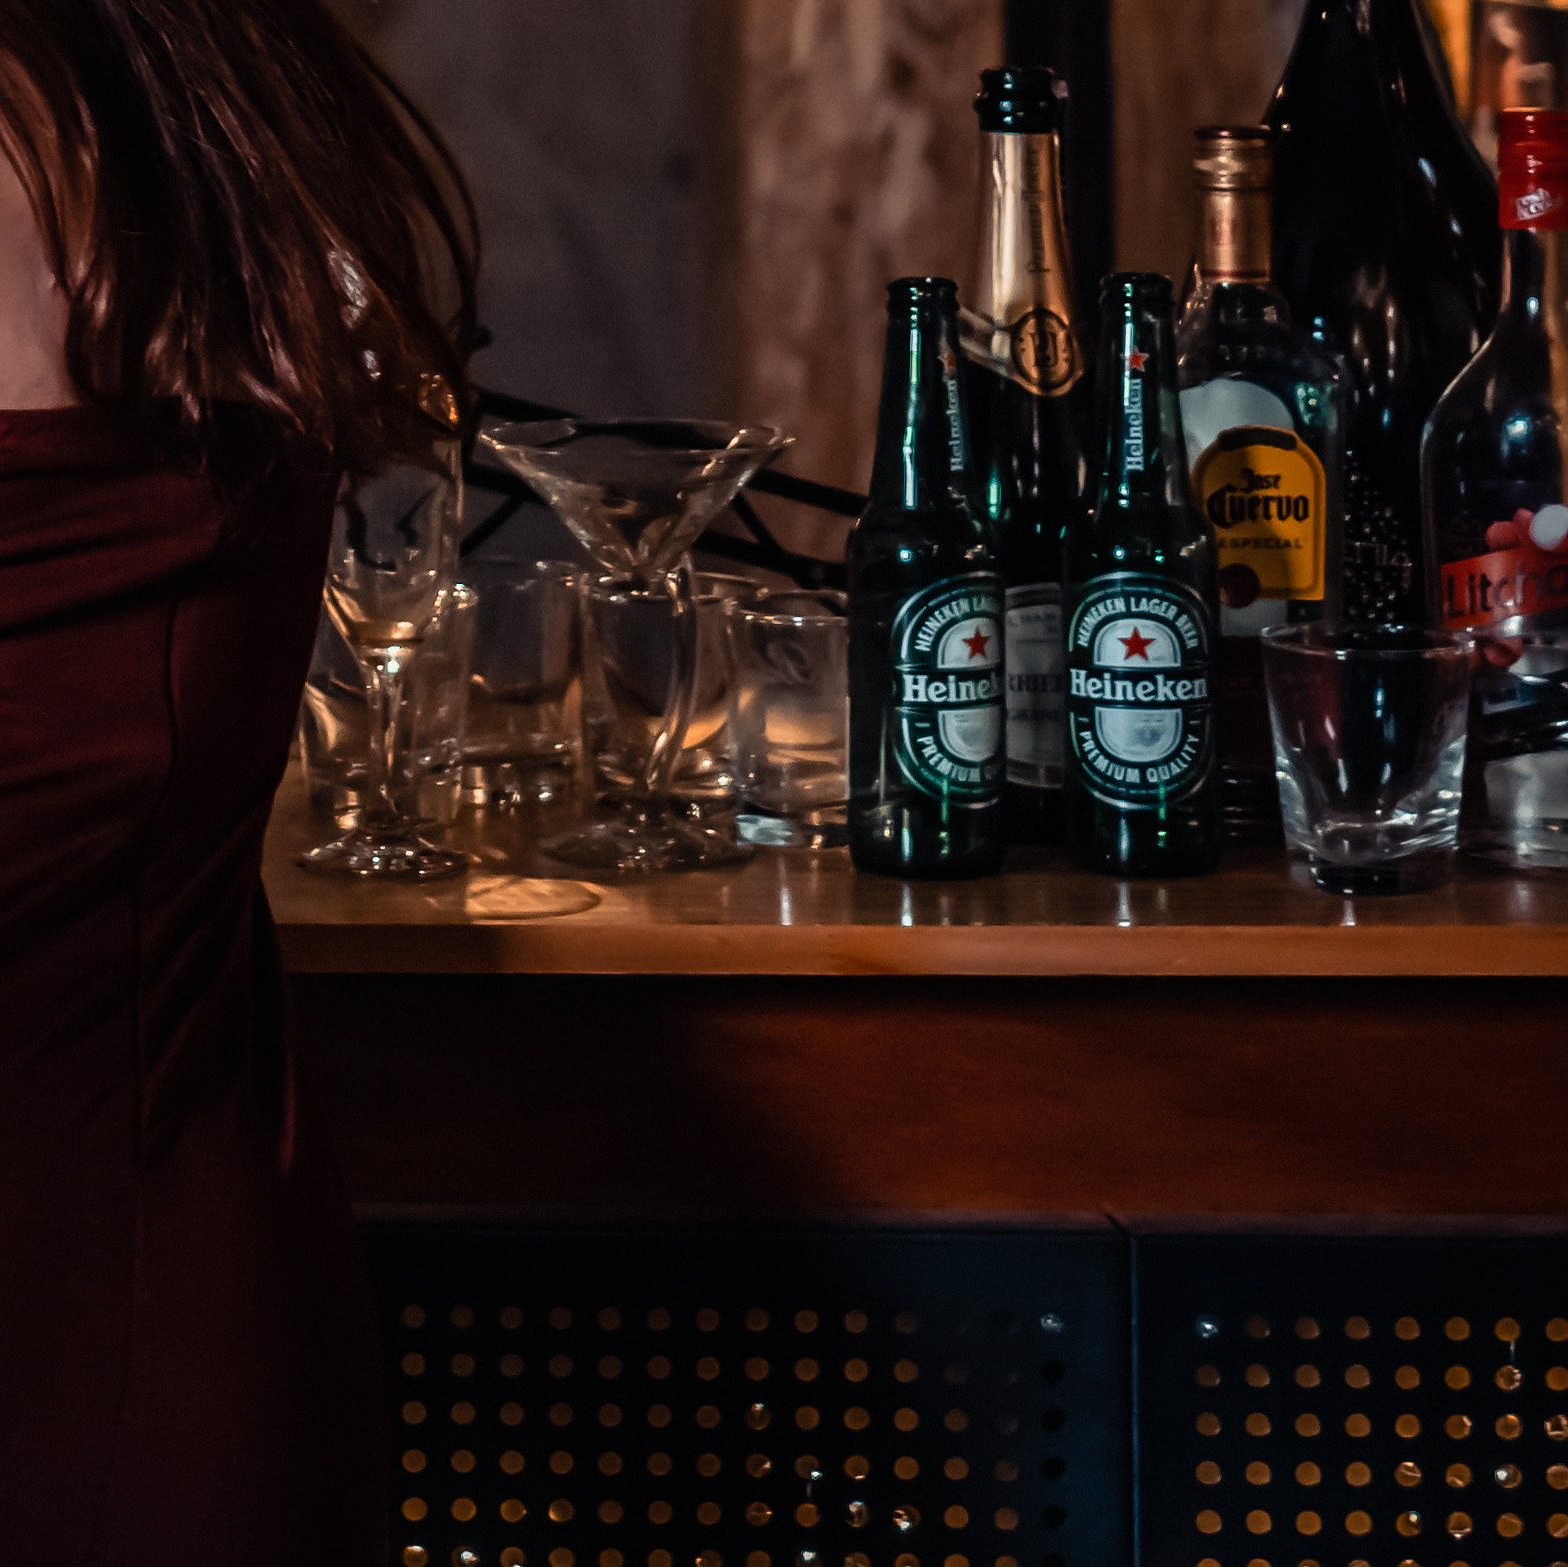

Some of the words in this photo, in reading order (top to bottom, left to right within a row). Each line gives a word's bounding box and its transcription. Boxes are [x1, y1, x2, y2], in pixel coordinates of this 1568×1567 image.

[1124, 378, 1144, 471] Heineken
[1206, 484, 1309, 529] Cuervo
[915, 598, 971, 652] HEINEKEN
[1077, 597, 1126, 647] HEINEKEN
[1130, 597, 1178, 620] LAGER
[1069, 668, 1207, 701] Heineken
[917, 736, 981, 782] PREMIUM
[1079, 731, 1140, 783] PREMIUM
[1146, 734, 1199, 783] QUALITY
